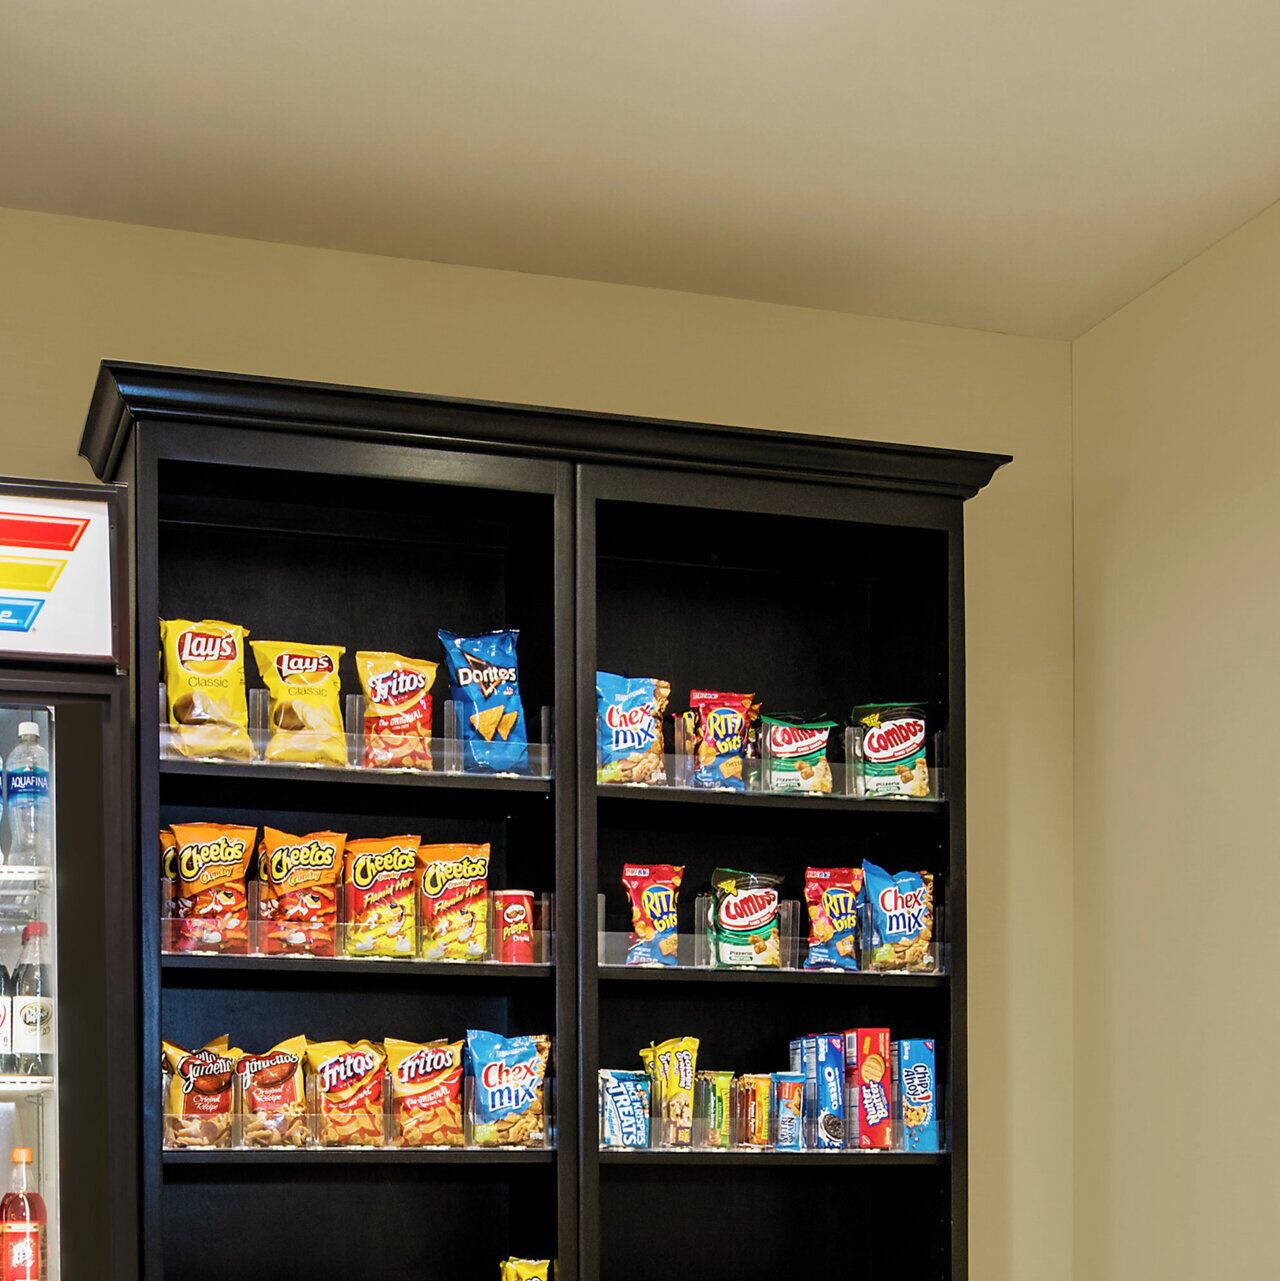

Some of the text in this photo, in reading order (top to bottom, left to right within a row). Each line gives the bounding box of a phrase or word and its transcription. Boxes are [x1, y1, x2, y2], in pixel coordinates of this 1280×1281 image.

[181, 632, 237, 661] Lay's
[281, 653, 333, 676] Lay's
[458, 666, 517, 686] Doritos
[187, 675, 229, 689] Classic
[287, 686, 328, 698] Classic
[368, 669, 426, 703] Fritos
[389, 710, 424, 726] ORIGINAL
[606, 702, 653, 730] Chex
[868, 719, 924, 752] Combos
[180, 836, 246, 881] Cheetos
[271, 840, 336, 883] Cheetos
[353, 848, 417, 889] Cheetos
[201, 866, 233, 885] Crunchy
[289, 869, 321, 886] Crunchy
[395, 877, 414, 891] Hot
[423, 856, 488, 898] Cheetos
[465, 883, 484, 899] Hot
[879, 887, 924, 913] Chex
[822, 893, 857, 919] RITZ
[832, 914, 857, 932] bits
[888, 908, 924, 934] mix
[177, 1055, 236, 1094] Gardetto'
[317, 1051, 374, 1092] Fritos
[397, 1049, 454, 1083] Fritos
[483, 1057, 538, 1088] Chex
[913, 1064, 929, 1095] Chips
[192, 1094, 221, 1104] Original
[419, 1087, 451, 1105] ORIGINAL
[490, 1080, 536, 1110] mix
[824, 1066, 839, 1110] OREO
[195, 1102, 219, 1111] Recipe
[612, 1080, 637, 1145] TREATS
